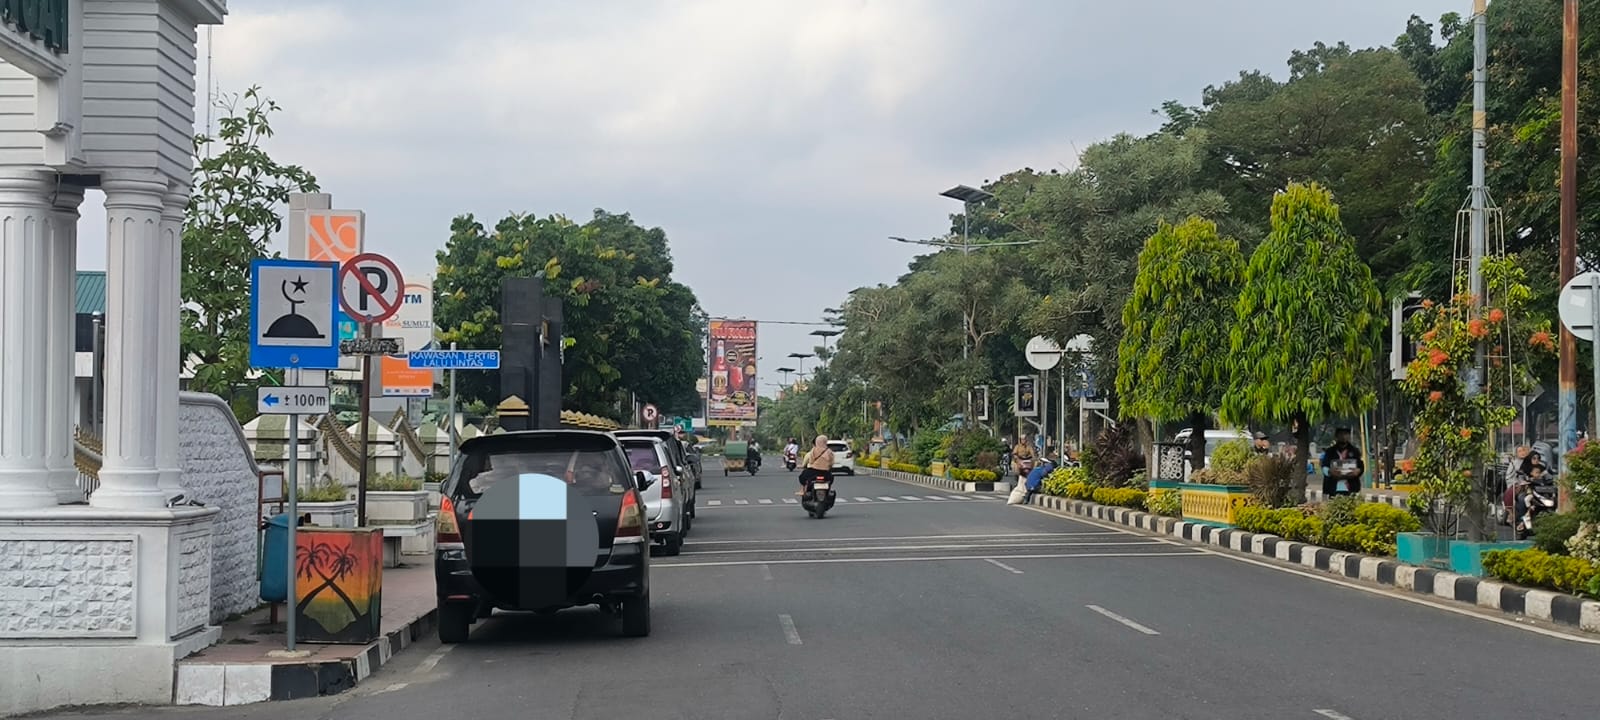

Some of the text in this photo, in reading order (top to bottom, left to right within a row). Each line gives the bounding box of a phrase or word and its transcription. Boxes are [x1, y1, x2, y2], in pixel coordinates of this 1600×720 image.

[359, 266, 389, 311] P
[403, 294, 422, 304] TM
[402, 320, 431, 328] SUMUT
[411, 352, 496, 361] KAWASAN TERTIB
[423, 359, 484, 367] LALU LINTAS
